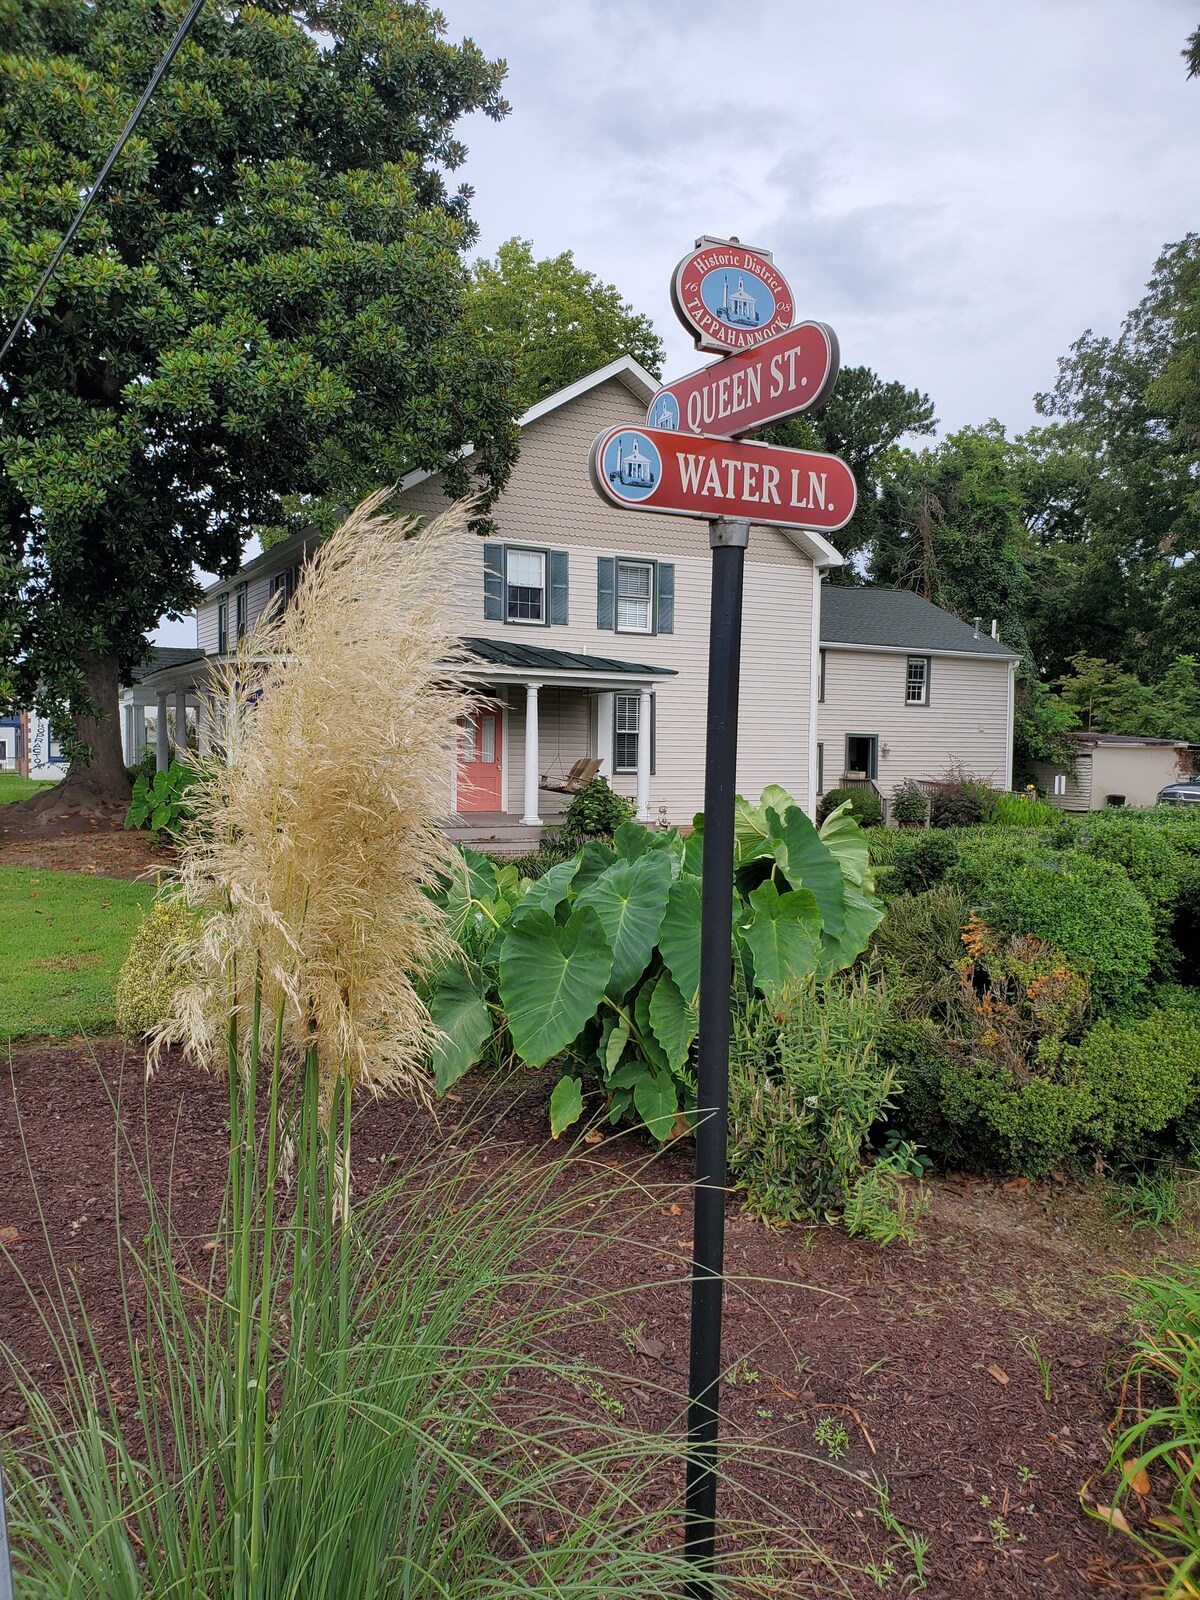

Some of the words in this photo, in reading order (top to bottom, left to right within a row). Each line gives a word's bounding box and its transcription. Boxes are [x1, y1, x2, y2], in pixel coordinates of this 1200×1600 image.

[684, 281, 700, 293] 16
[776, 301, 792, 313] 08
[693, 250, 740, 275] Historic
[743, 254, 783, 294] District
[687, 297, 790, 347] TAPPAHANNOCK
[687, 363, 762, 434] QUEEN
[770, 345, 807, 399] ST.
[675, 452, 781, 505] WATER
[789, 468, 835, 512] LN.
